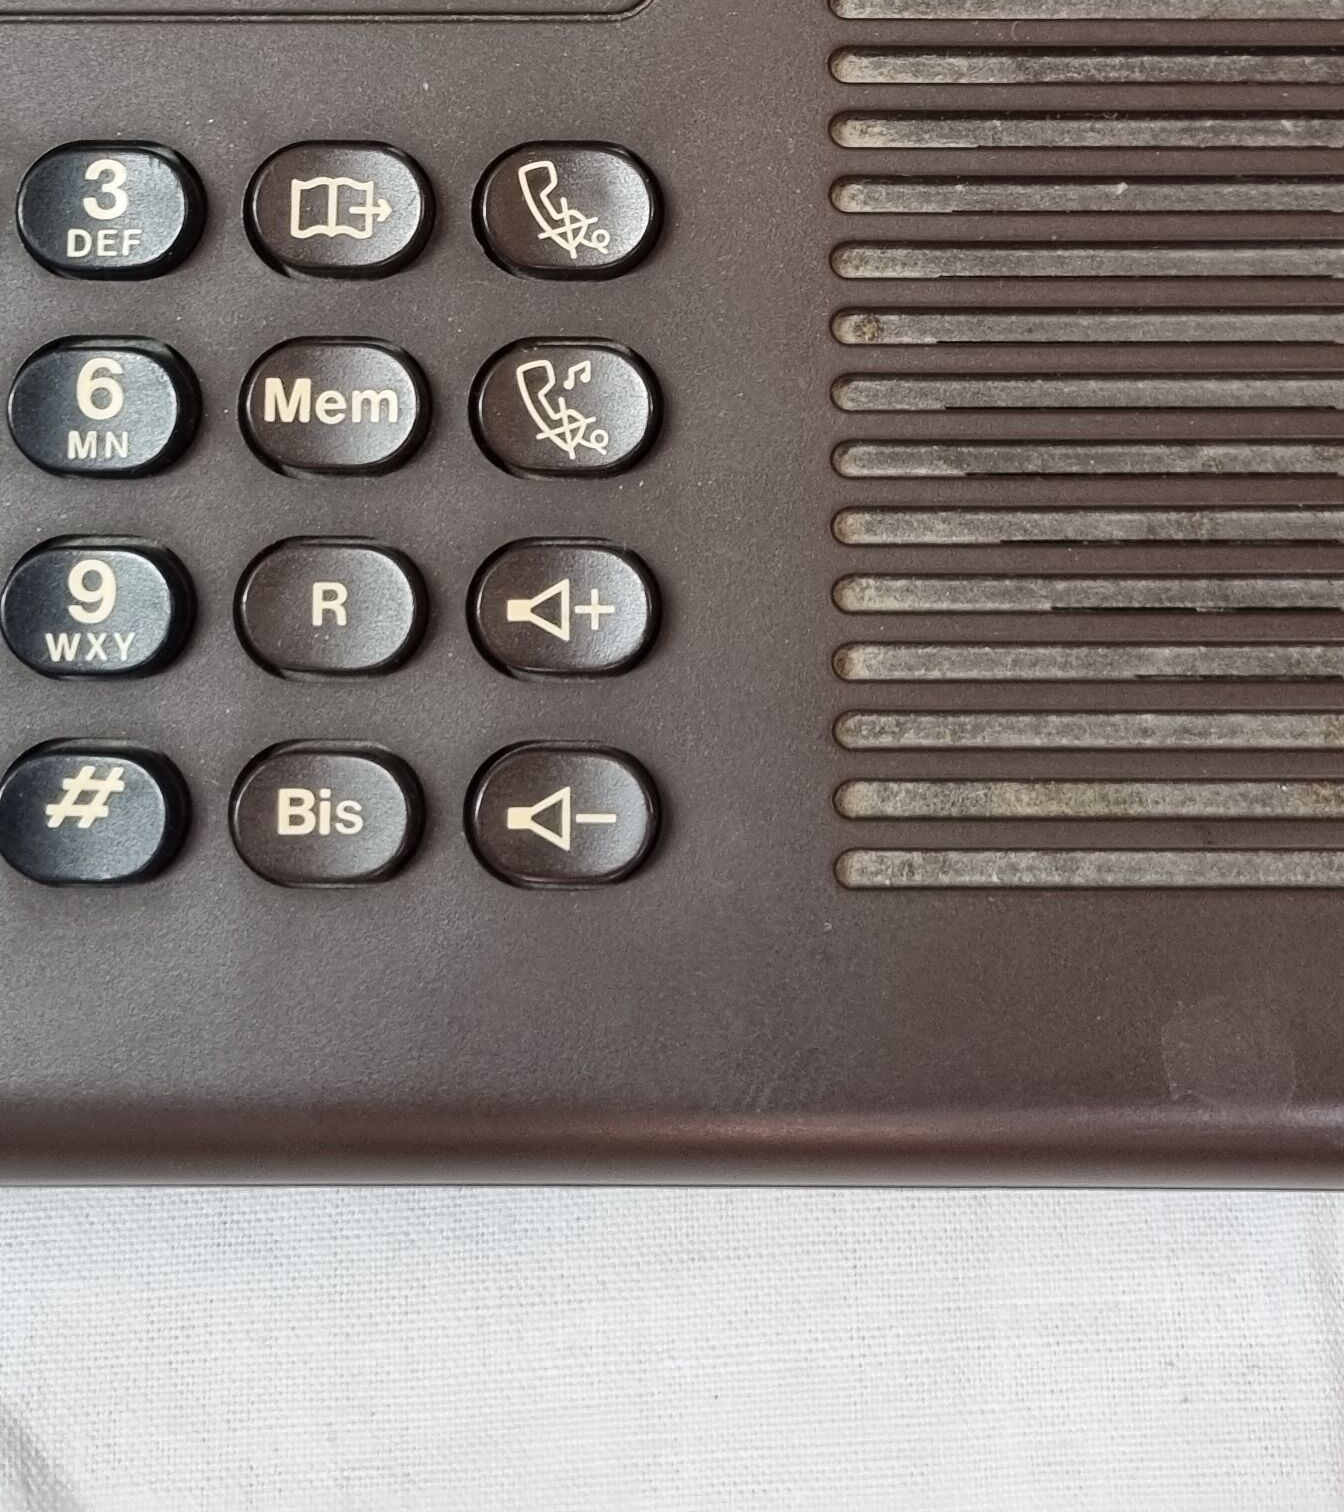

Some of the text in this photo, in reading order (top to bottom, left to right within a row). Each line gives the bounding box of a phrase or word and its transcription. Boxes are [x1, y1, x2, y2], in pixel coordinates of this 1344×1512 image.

[82, 158, 129, 220] 3
[66, 228, 143, 257] DEF
[75, 357, 125, 420] 6
[263, 377, 399, 424] Mem
[66, 431, 130, 460] MN
[66, 559, 117, 624] 9
[312, 581, 348, 627] R
[44, 632, 137, 662] WXY
[276, 787, 364, 836] Bis
